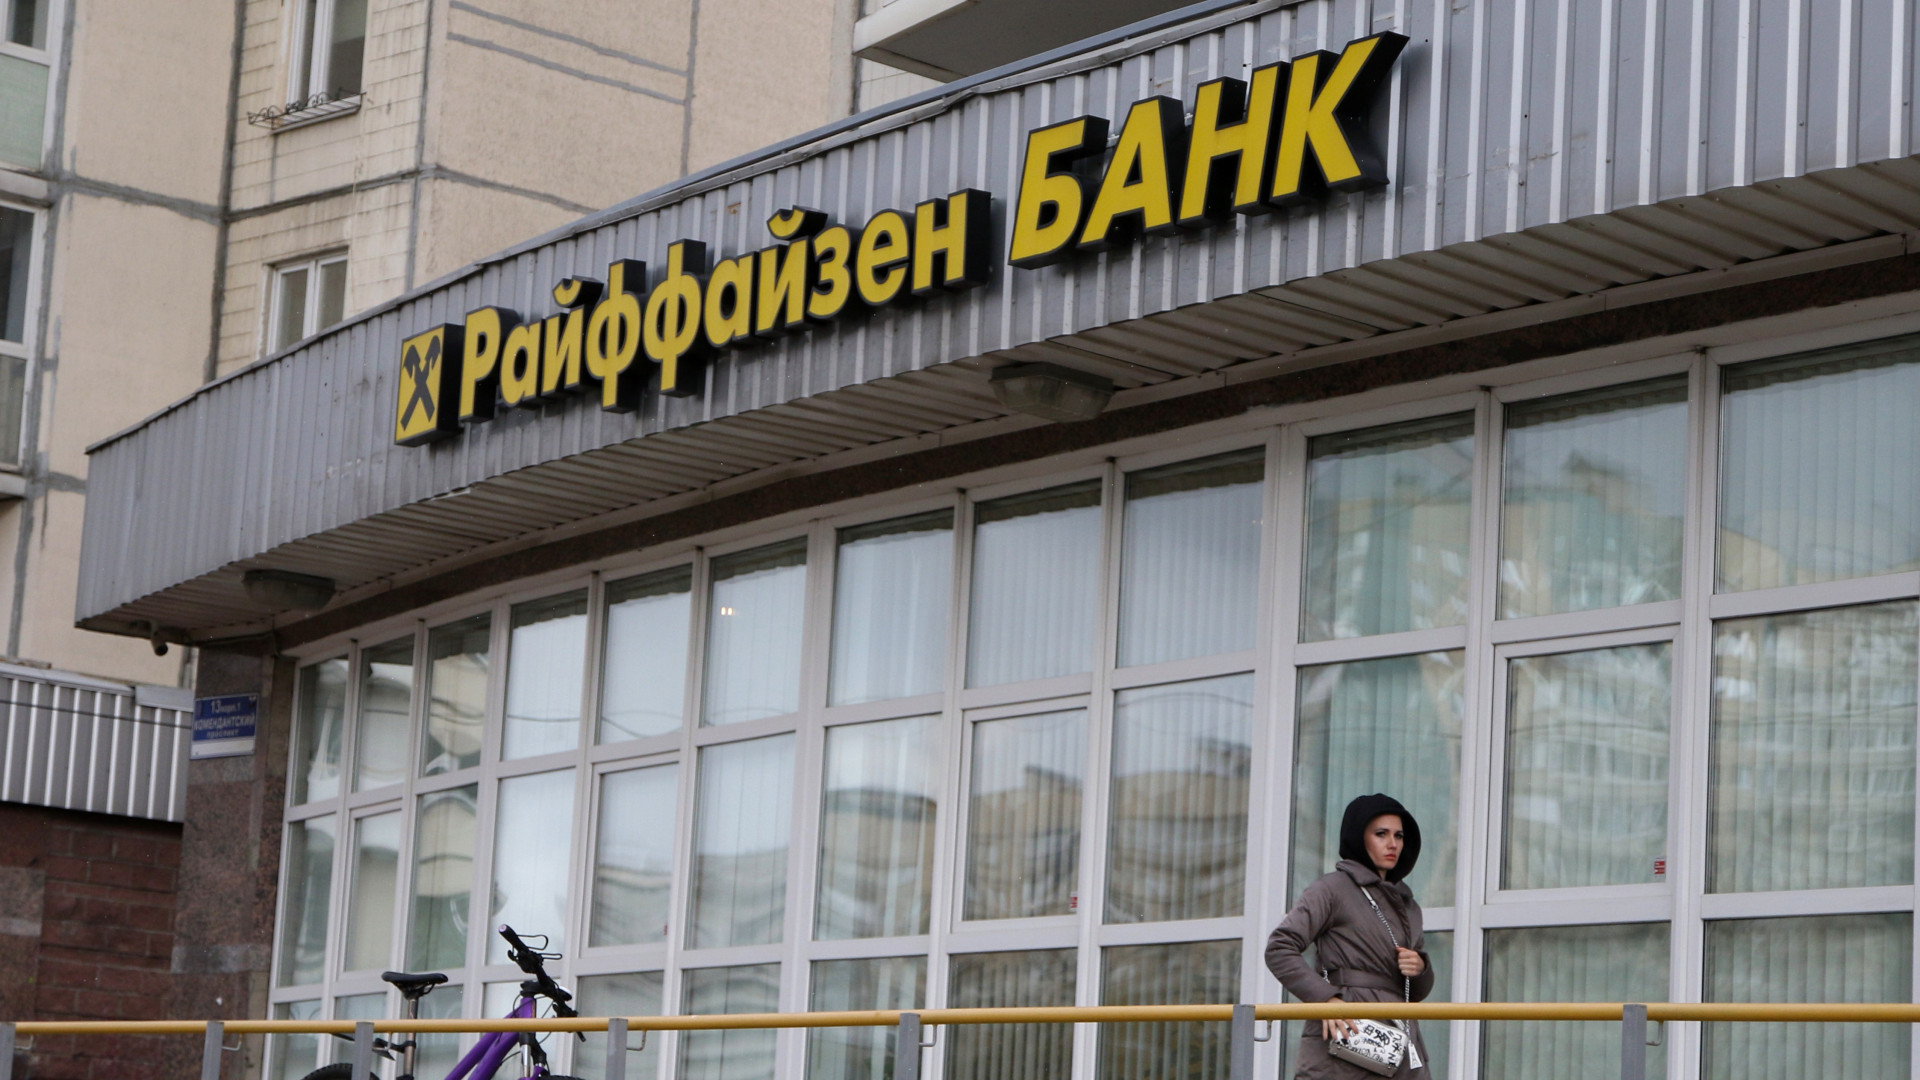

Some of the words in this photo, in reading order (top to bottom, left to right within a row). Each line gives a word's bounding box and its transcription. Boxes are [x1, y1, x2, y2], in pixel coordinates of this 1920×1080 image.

[459, 190, 975, 418] Райффайзен
[1009, 36, 1386, 266] БАНК
[194, 713, 255, 731] КОМЕНДАНТСКИЙ
